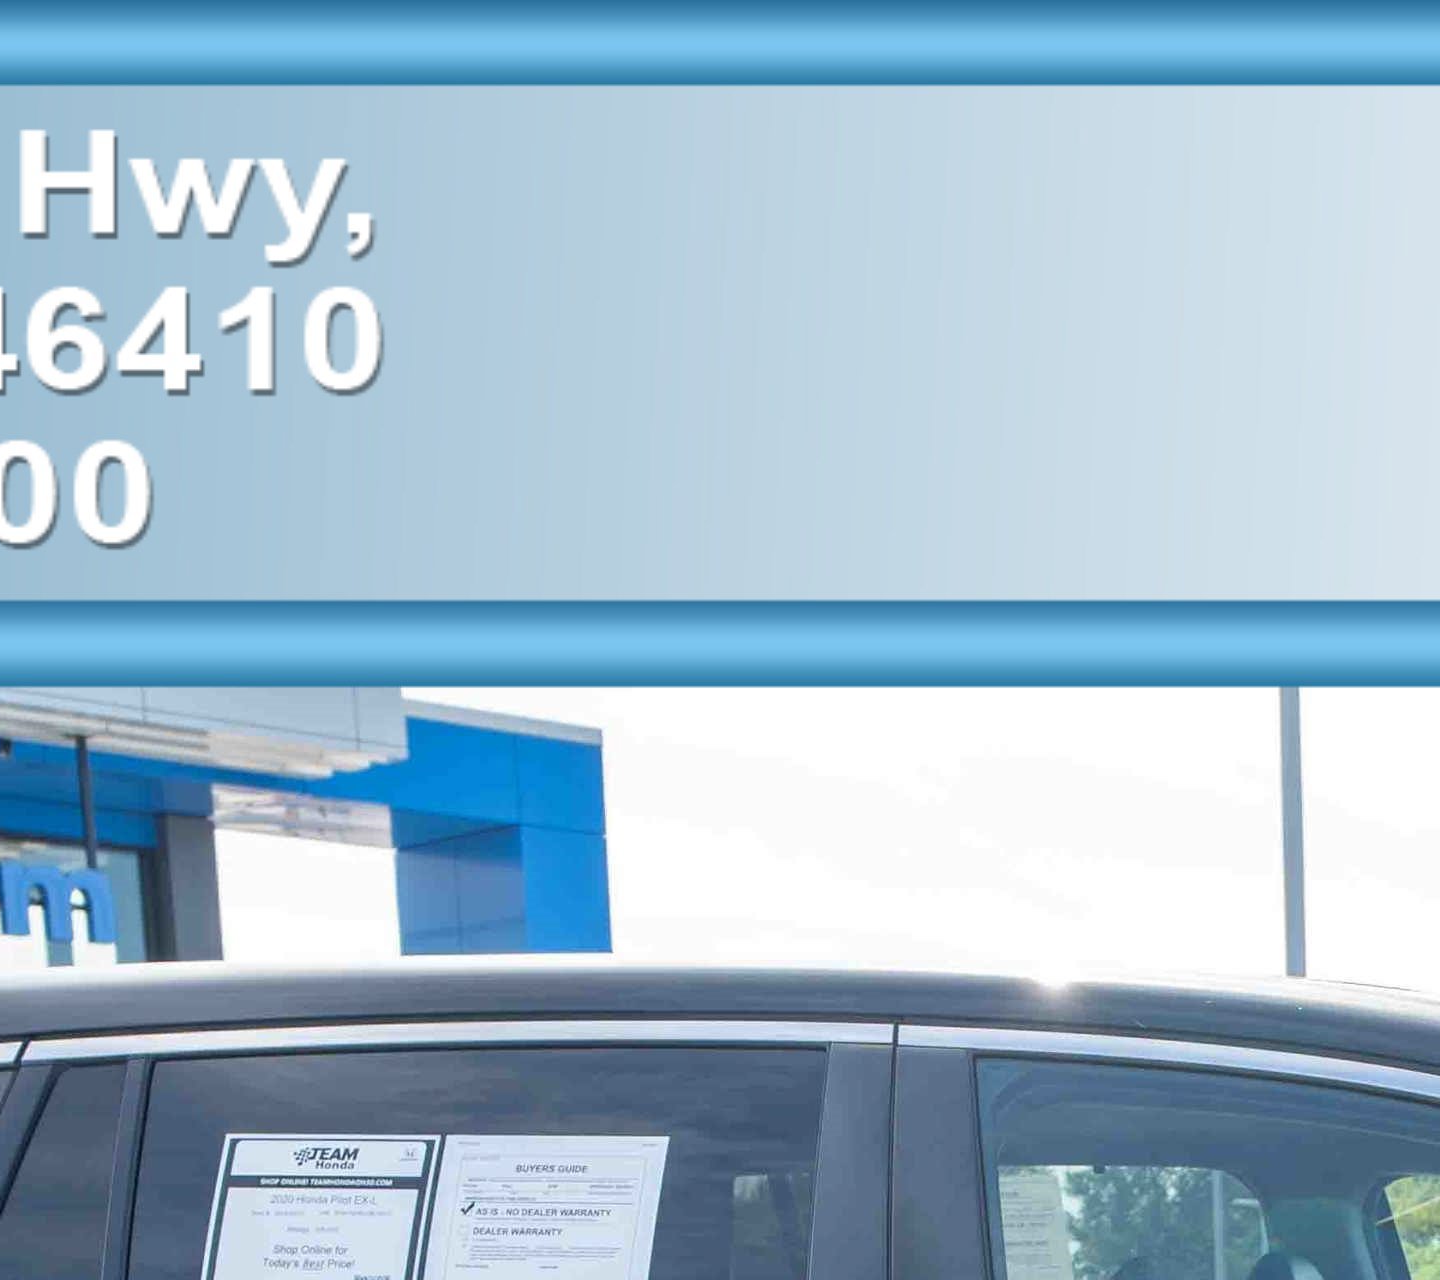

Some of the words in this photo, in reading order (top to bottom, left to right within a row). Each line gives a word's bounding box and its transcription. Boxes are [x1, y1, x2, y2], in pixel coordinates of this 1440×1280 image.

[309, 1147, 360, 1161] TEAM
[315, 1160, 355, 1170] Honda
[515, 1164, 555, 1174] BUYERS
[557, 1165, 589, 1174] GUIDE
[296, 1194, 327, 1205] Honda
[475, 1208, 489, 1216] AS
[490, 1208, 499, 1216] IS
[505, 1208, 520, 1217] NO
[521, 1209, 557, 1217] DEALER
[559, 1209, 612, 1218] WARRANTY
[472, 1227, 509, 1237] DEALER
[511, 1228, 564, 1237] WARRANTY
[273, 1244, 299, 1257] Shop
[301, 1245, 332, 1256] Online
[334, 1246, 349, 1256] for
[263, 1257, 300, 1270] Today's
